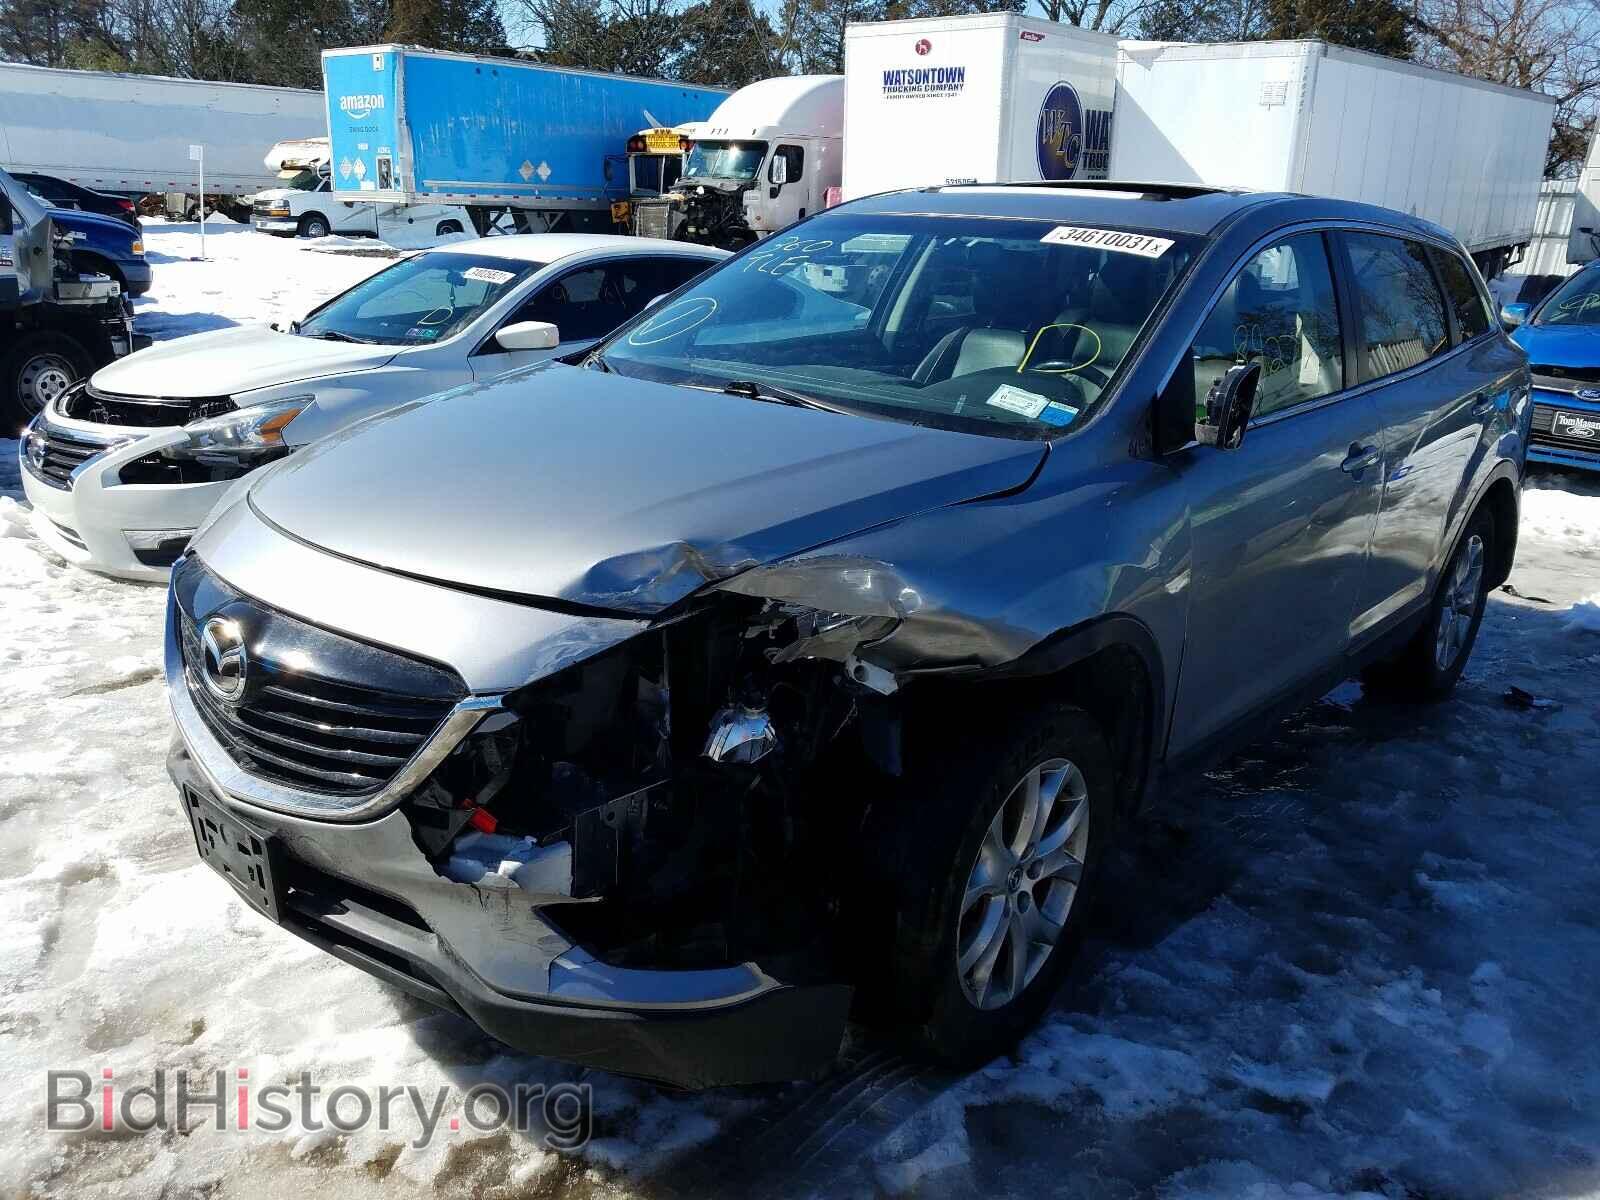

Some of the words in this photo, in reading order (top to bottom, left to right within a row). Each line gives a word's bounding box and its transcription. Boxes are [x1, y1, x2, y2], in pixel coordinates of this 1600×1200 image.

[883, 66, 965, 85] WATSONTOWN
[882, 85, 922, 94] TRUCKING
[924, 83, 964, 93] COMPANY
[340, 94, 385, 111] amazon
[1059, 227, 1155, 251] 34610031
